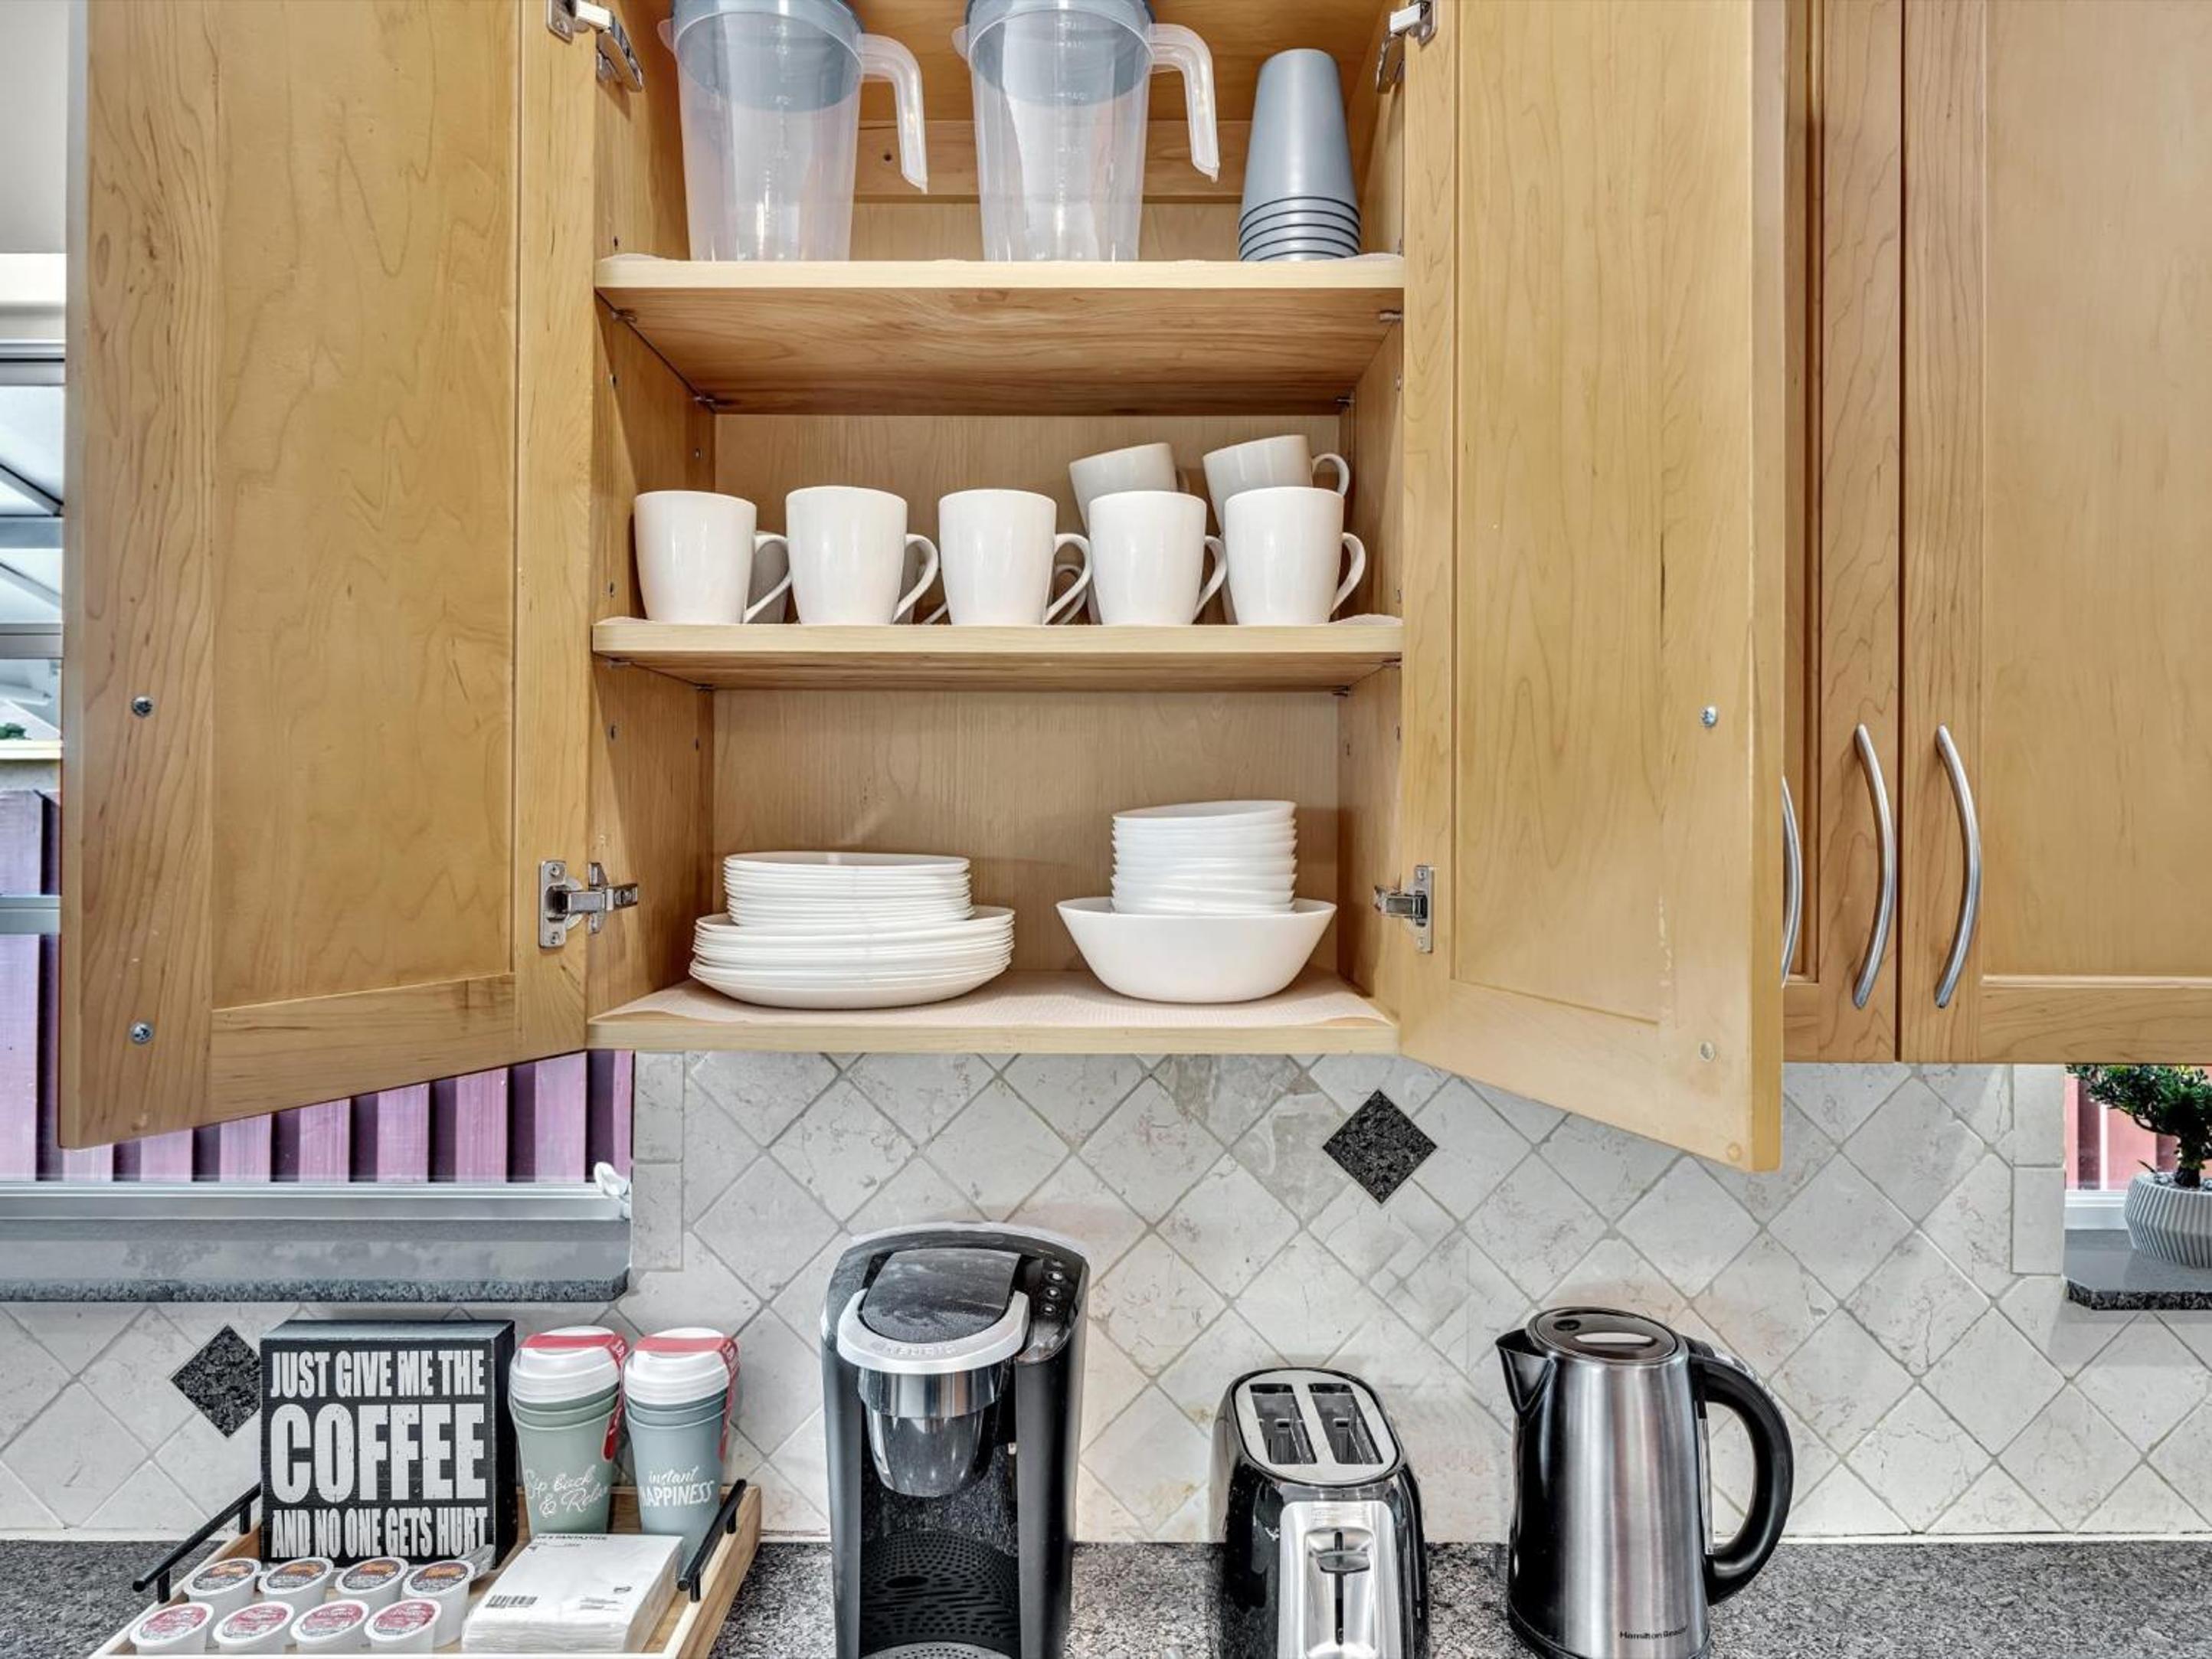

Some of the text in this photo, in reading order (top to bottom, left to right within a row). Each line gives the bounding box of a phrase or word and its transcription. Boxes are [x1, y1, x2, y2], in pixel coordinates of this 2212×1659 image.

[270, 1350, 486, 1399] JUST GIVE ME THE
[270, 1403, 486, 1504] COFFEE
[639, 1481, 715, 1507] HAPPINESS
[649, 1465, 699, 1486] instant
[271, 1507, 488, 1558] AND NO ONE GETS HURT
[1619, 1630, 1662, 1640] Hamilton
